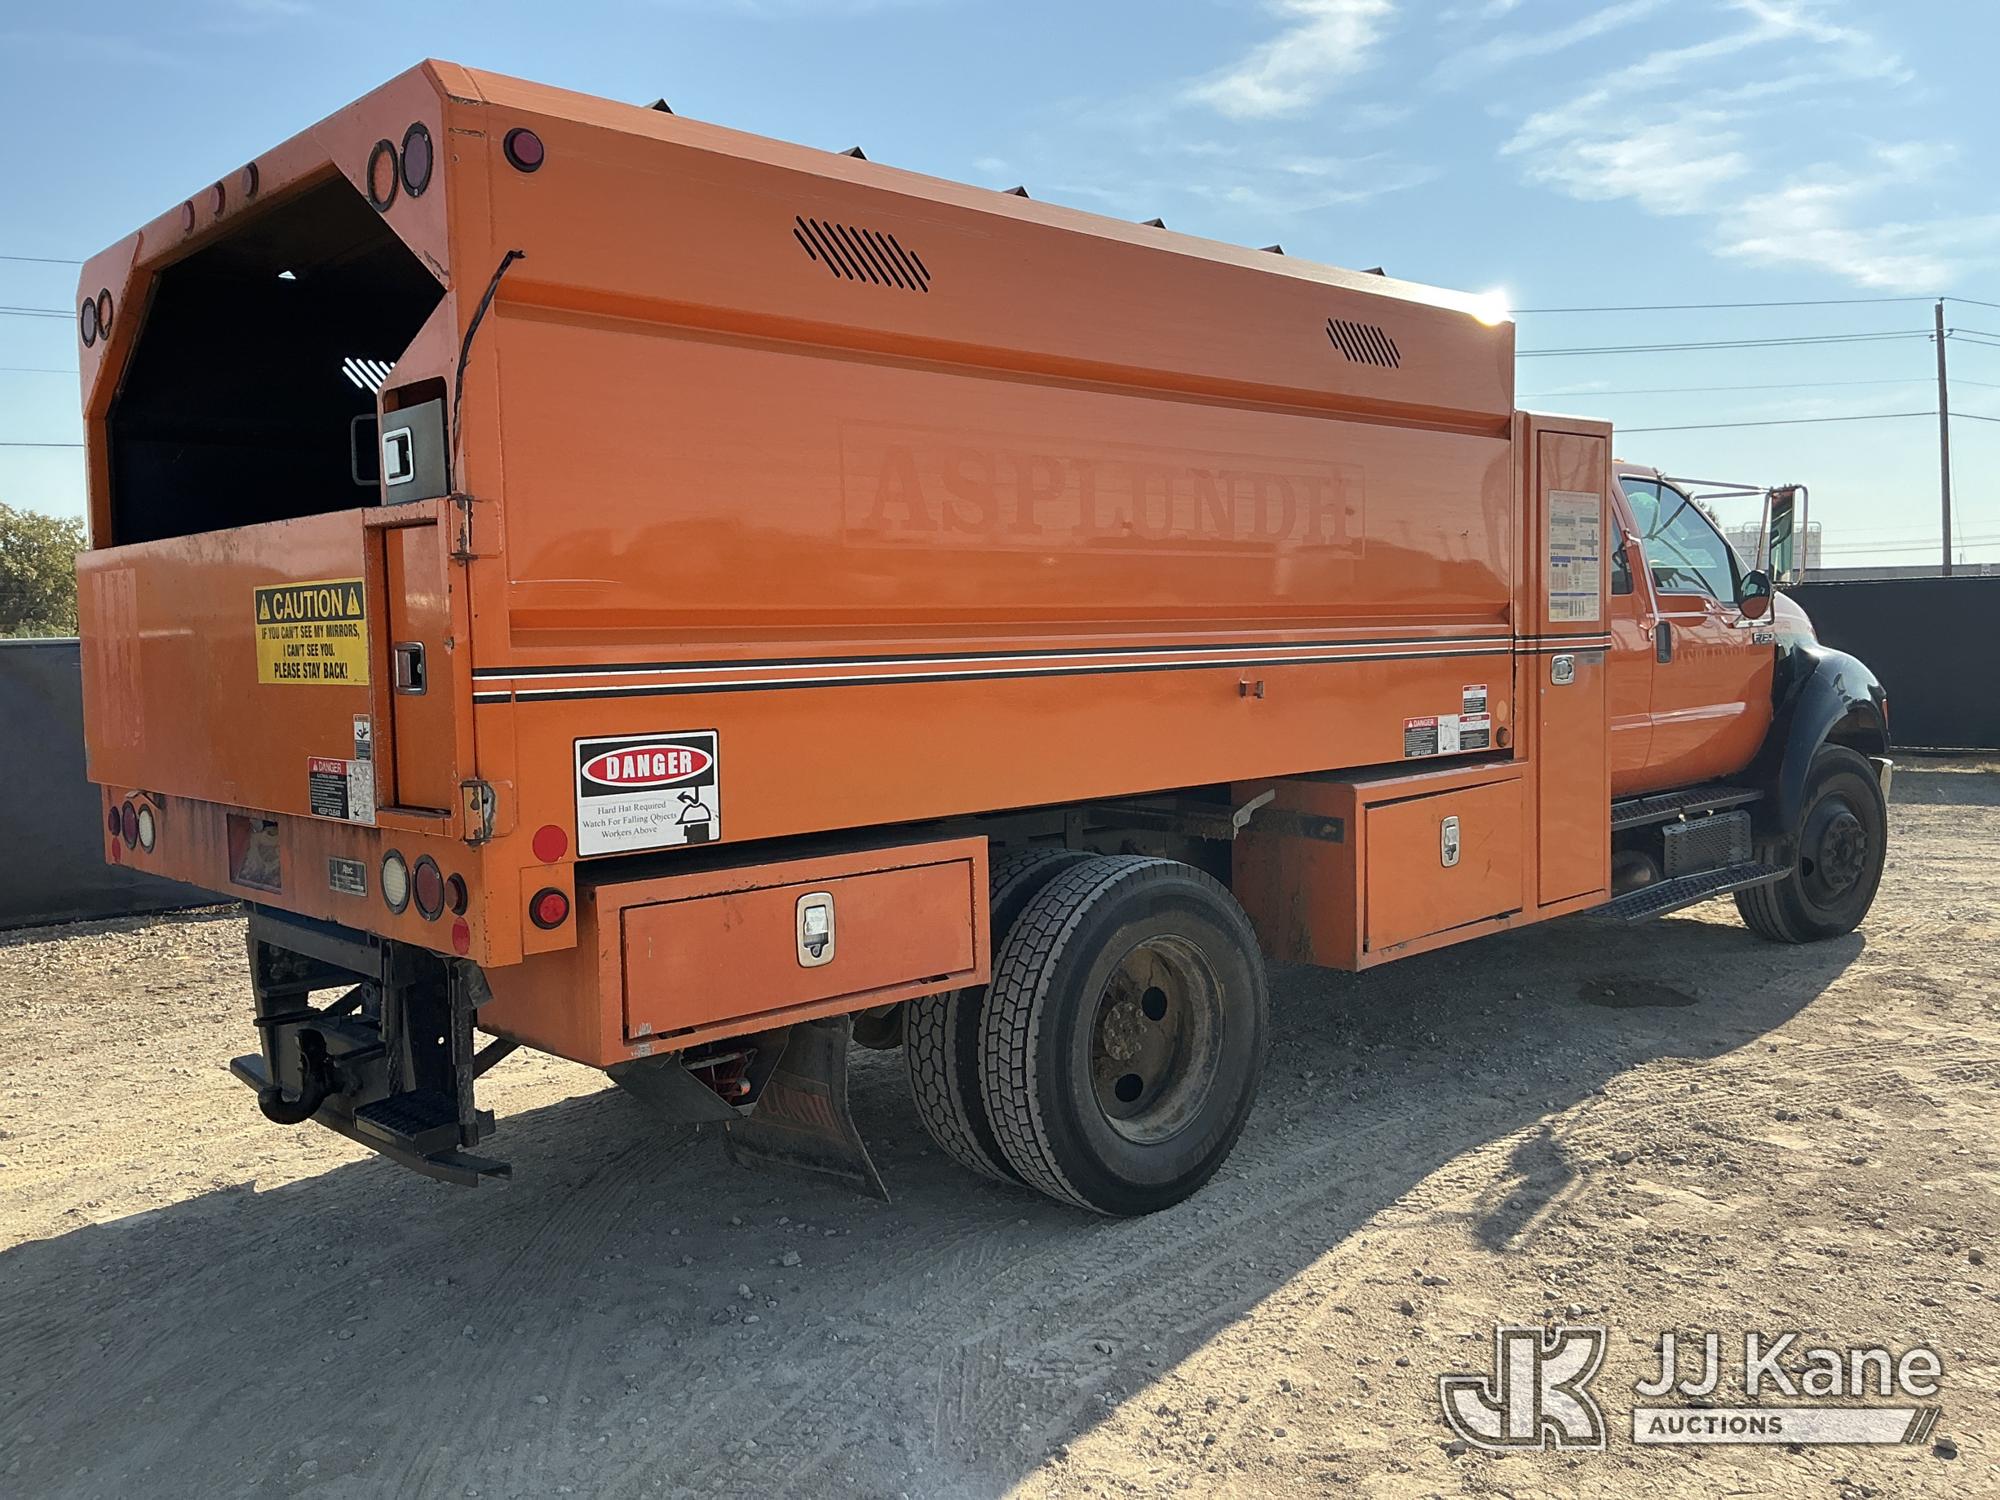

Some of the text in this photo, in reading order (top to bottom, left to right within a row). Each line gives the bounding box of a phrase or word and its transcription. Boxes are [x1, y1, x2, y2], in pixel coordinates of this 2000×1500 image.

[861, 443, 1354, 545] ASPLUNDH
[273, 589, 343, 620] CAUTION
[262, 623, 360, 640] IF YOU CAN'T SEE MY MIRRORS,
[287, 644, 305, 656] CAN'T
[306, 643, 319, 656] SEE
[320, 643, 335, 656] YOU.
[274, 662, 348, 679] PLEASE STAY BACK!
[1413, 719, 1434, 727] DANGER
[318, 761, 342, 773] DANGER
[606, 751, 692, 780] DANGER
[597, 801, 667, 815] Hard Hat Required
[582, 812, 678, 828] Watch For Falling Objects
[601, 825, 658, 839] Workers Above
